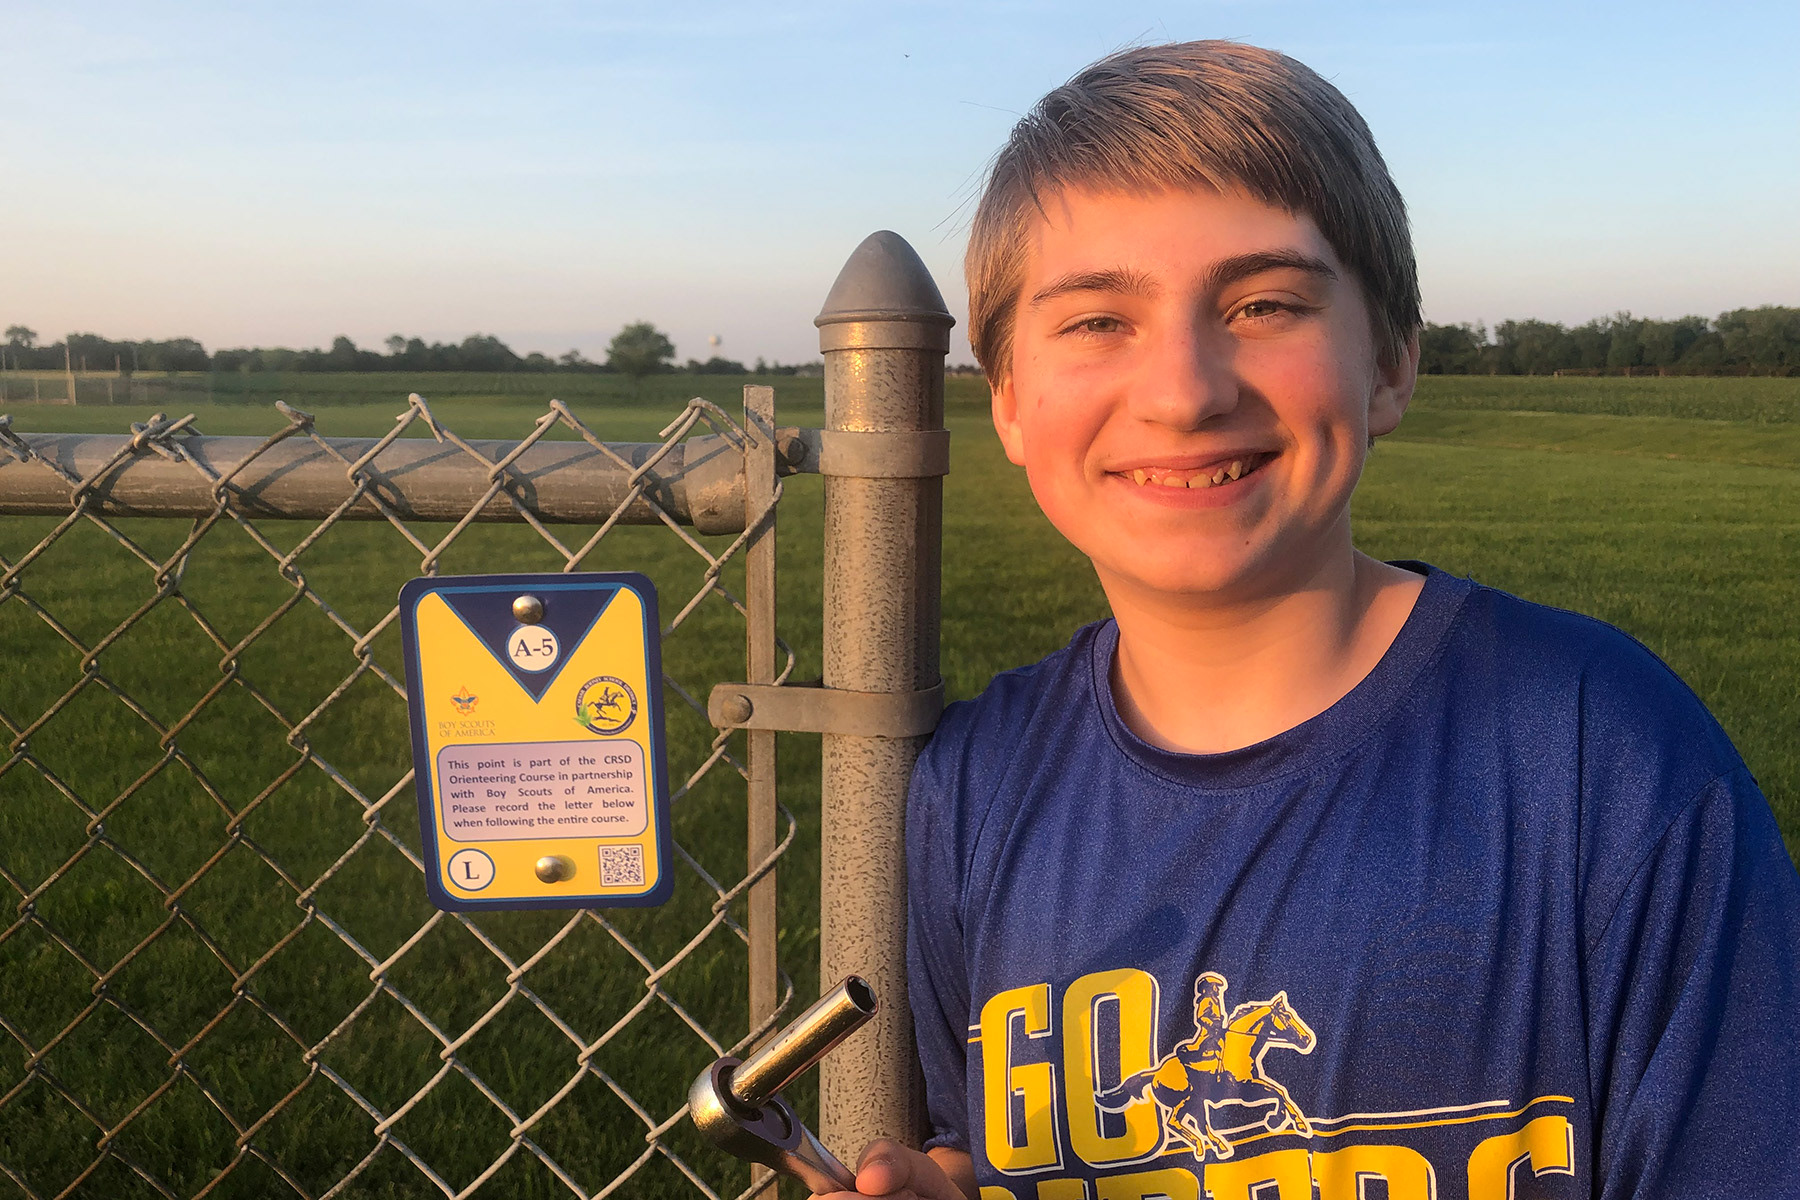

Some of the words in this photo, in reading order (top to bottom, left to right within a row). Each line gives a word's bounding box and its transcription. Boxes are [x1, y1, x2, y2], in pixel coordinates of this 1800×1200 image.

[514, 638, 554, 657] A-5
[438, 720, 456, 729] BOY
[460, 720, 496, 728] SCOUTS
[440, 730, 450, 738] OF
[456, 728, 496, 736] AMERICA
[448, 760, 469, 770] This
[478, 759, 505, 770] point
[514, 759, 521, 768] is
[530, 758, 551, 769] part
[560, 757, 570, 766] of
[578, 757, 596, 765] the
[604, 755, 632, 764] CRSD
[449, 774, 516, 784] Orienteering
[519, 773, 555, 782] Course
[559, 771, 568, 780] in
[572, 770, 633, 781] partnership
[451, 789, 474, 799] with
[487, 789, 506, 799] Boy
[518, 787, 552, 796] Scouts
[565, 786, 575, 795] of
[587, 785, 633, 794] America.
[452, 804, 486, 813] Please
[495, 802, 529, 812] record
[538, 802, 555, 810] the
[565, 801, 593, 809] letter
[602, 799, 634, 808] below
[454, 818, 482, 828] when
[486, 817, 534, 827] following
[537, 816, 554, 825] the
[558, 815, 588, 824] entire
[591, 814, 629, 823] course.
[463, 861, 480, 880] L
[980, 968, 1161, 1174] GO
